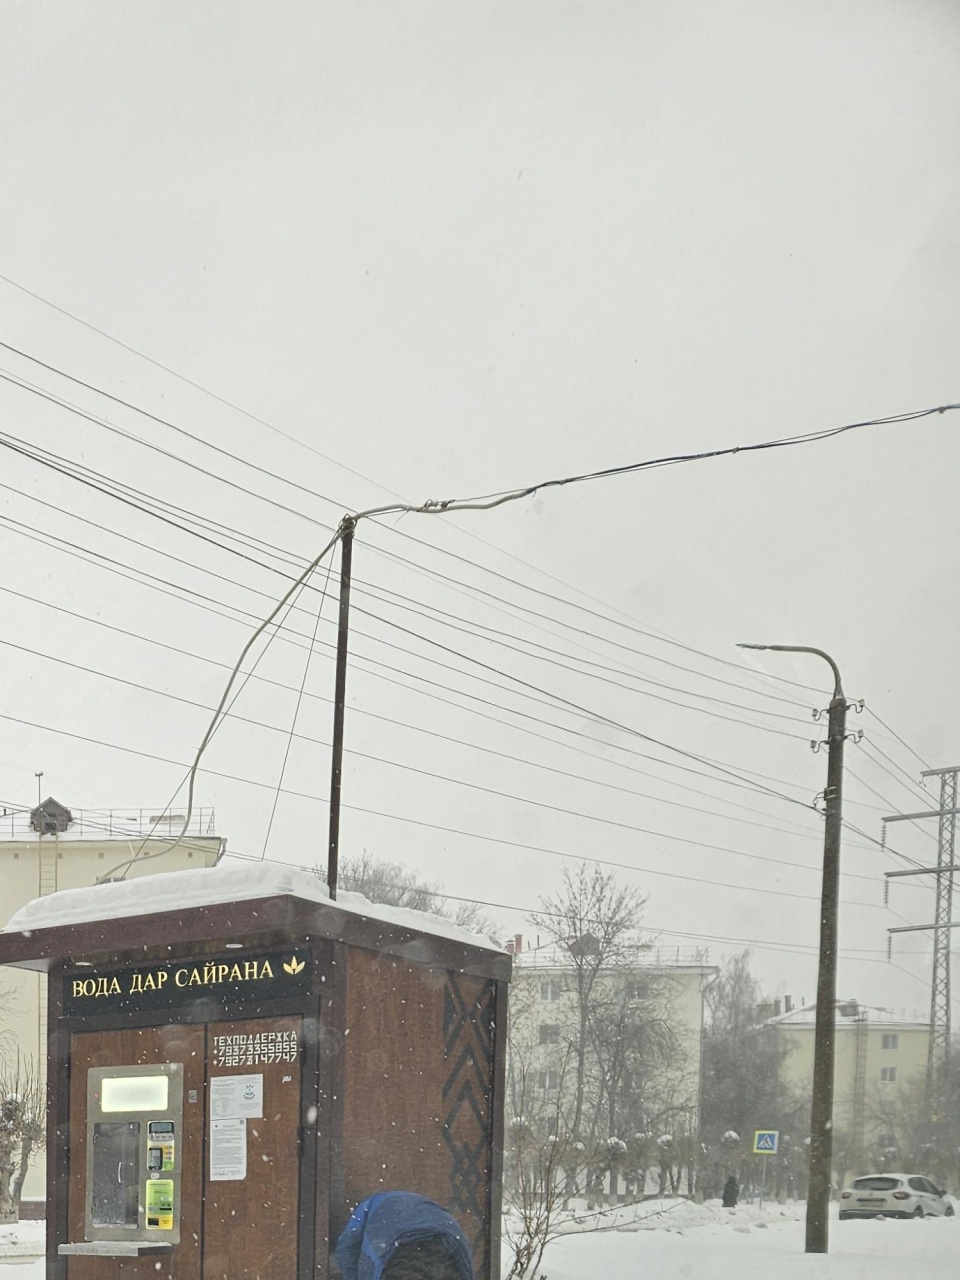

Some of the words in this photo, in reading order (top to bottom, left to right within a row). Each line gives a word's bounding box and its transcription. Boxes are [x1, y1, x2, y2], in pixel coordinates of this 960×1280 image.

[72, 976, 122, 998] ВОДА
[129, 971, 168, 995] ДАР
[175, 960, 275, 988] САЙРАНА
[213, 1030, 297, 1047] ТЕХПОДДЕРЖКА
[212, 1041, 298, 1056] +79373355855
[212, 1052, 298, 1068] +79273147747
